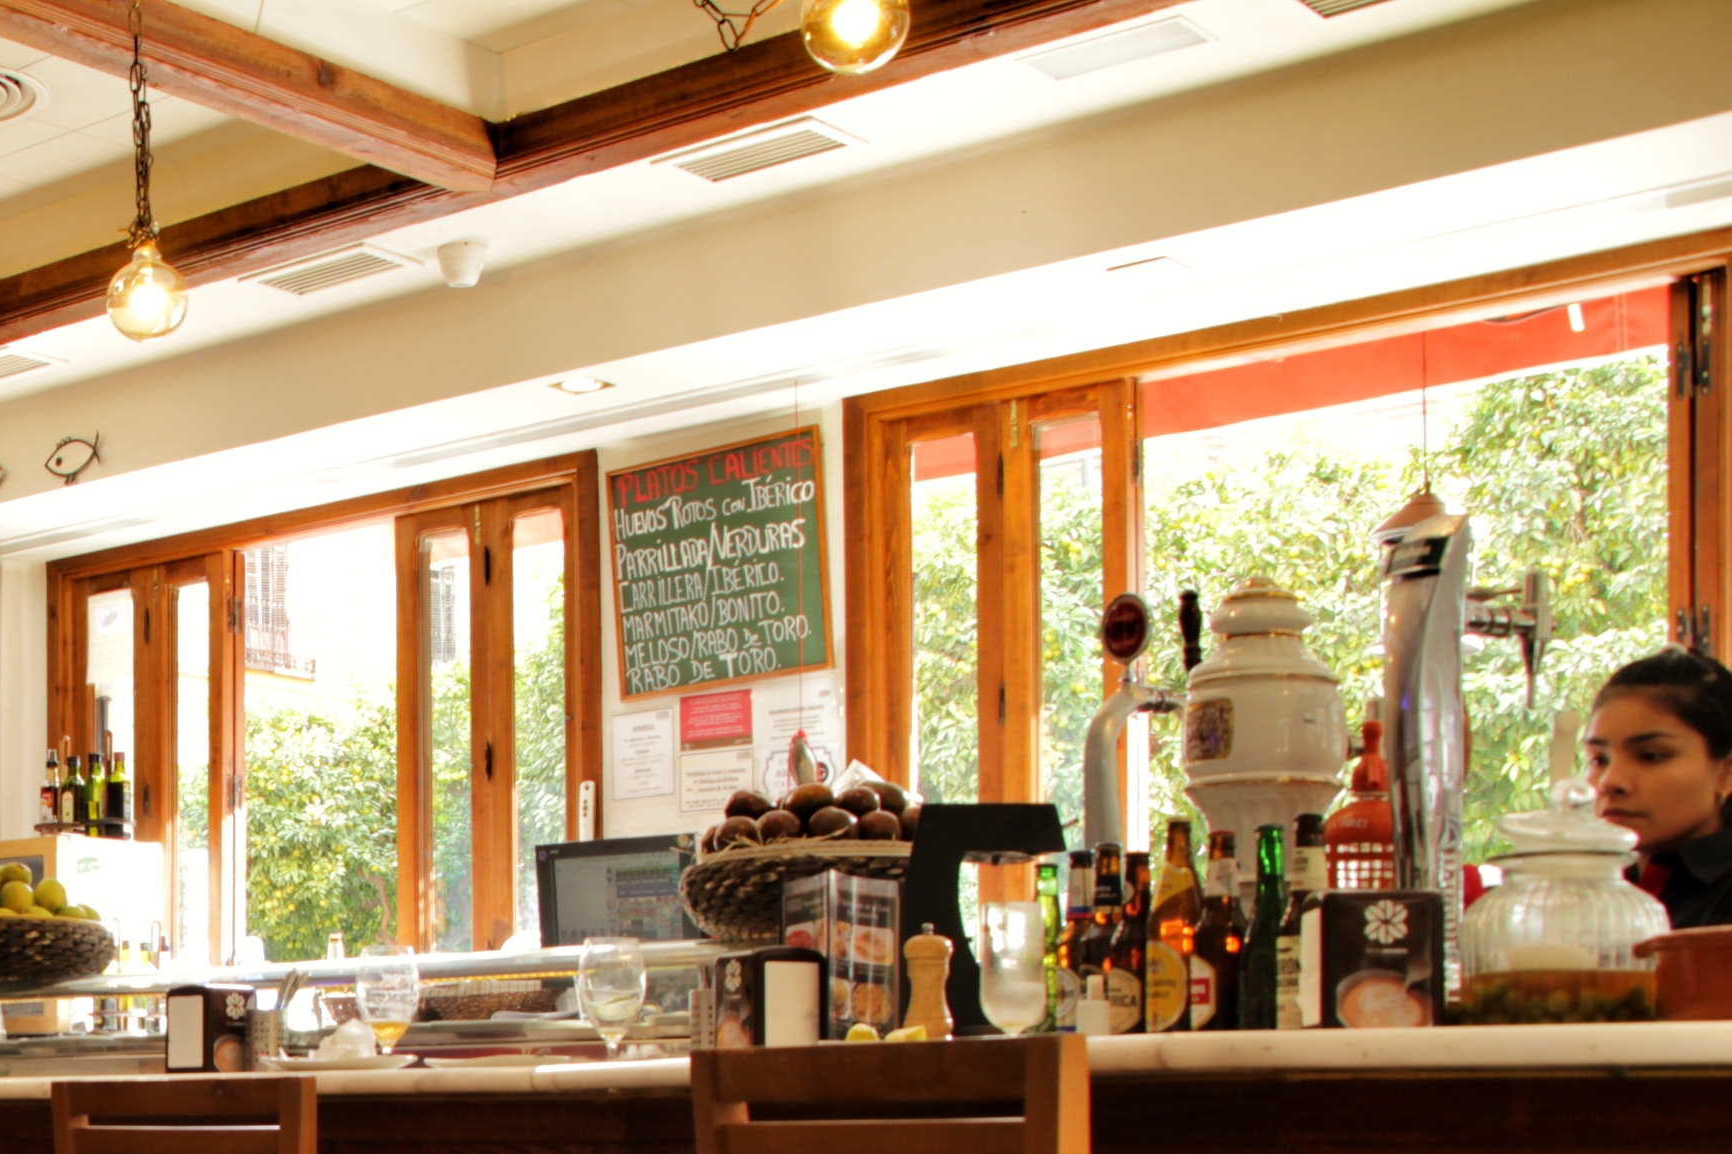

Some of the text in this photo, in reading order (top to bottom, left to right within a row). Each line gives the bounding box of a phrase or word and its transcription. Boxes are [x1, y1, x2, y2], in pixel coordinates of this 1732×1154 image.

[617, 437, 816, 508] PLATOS CALIENTES
[614, 506, 668, 541] HUEVOS
[664, 495, 717, 530] ROTOS
[627, 662, 681, 695] RABO
[688, 659, 715, 684] DE
